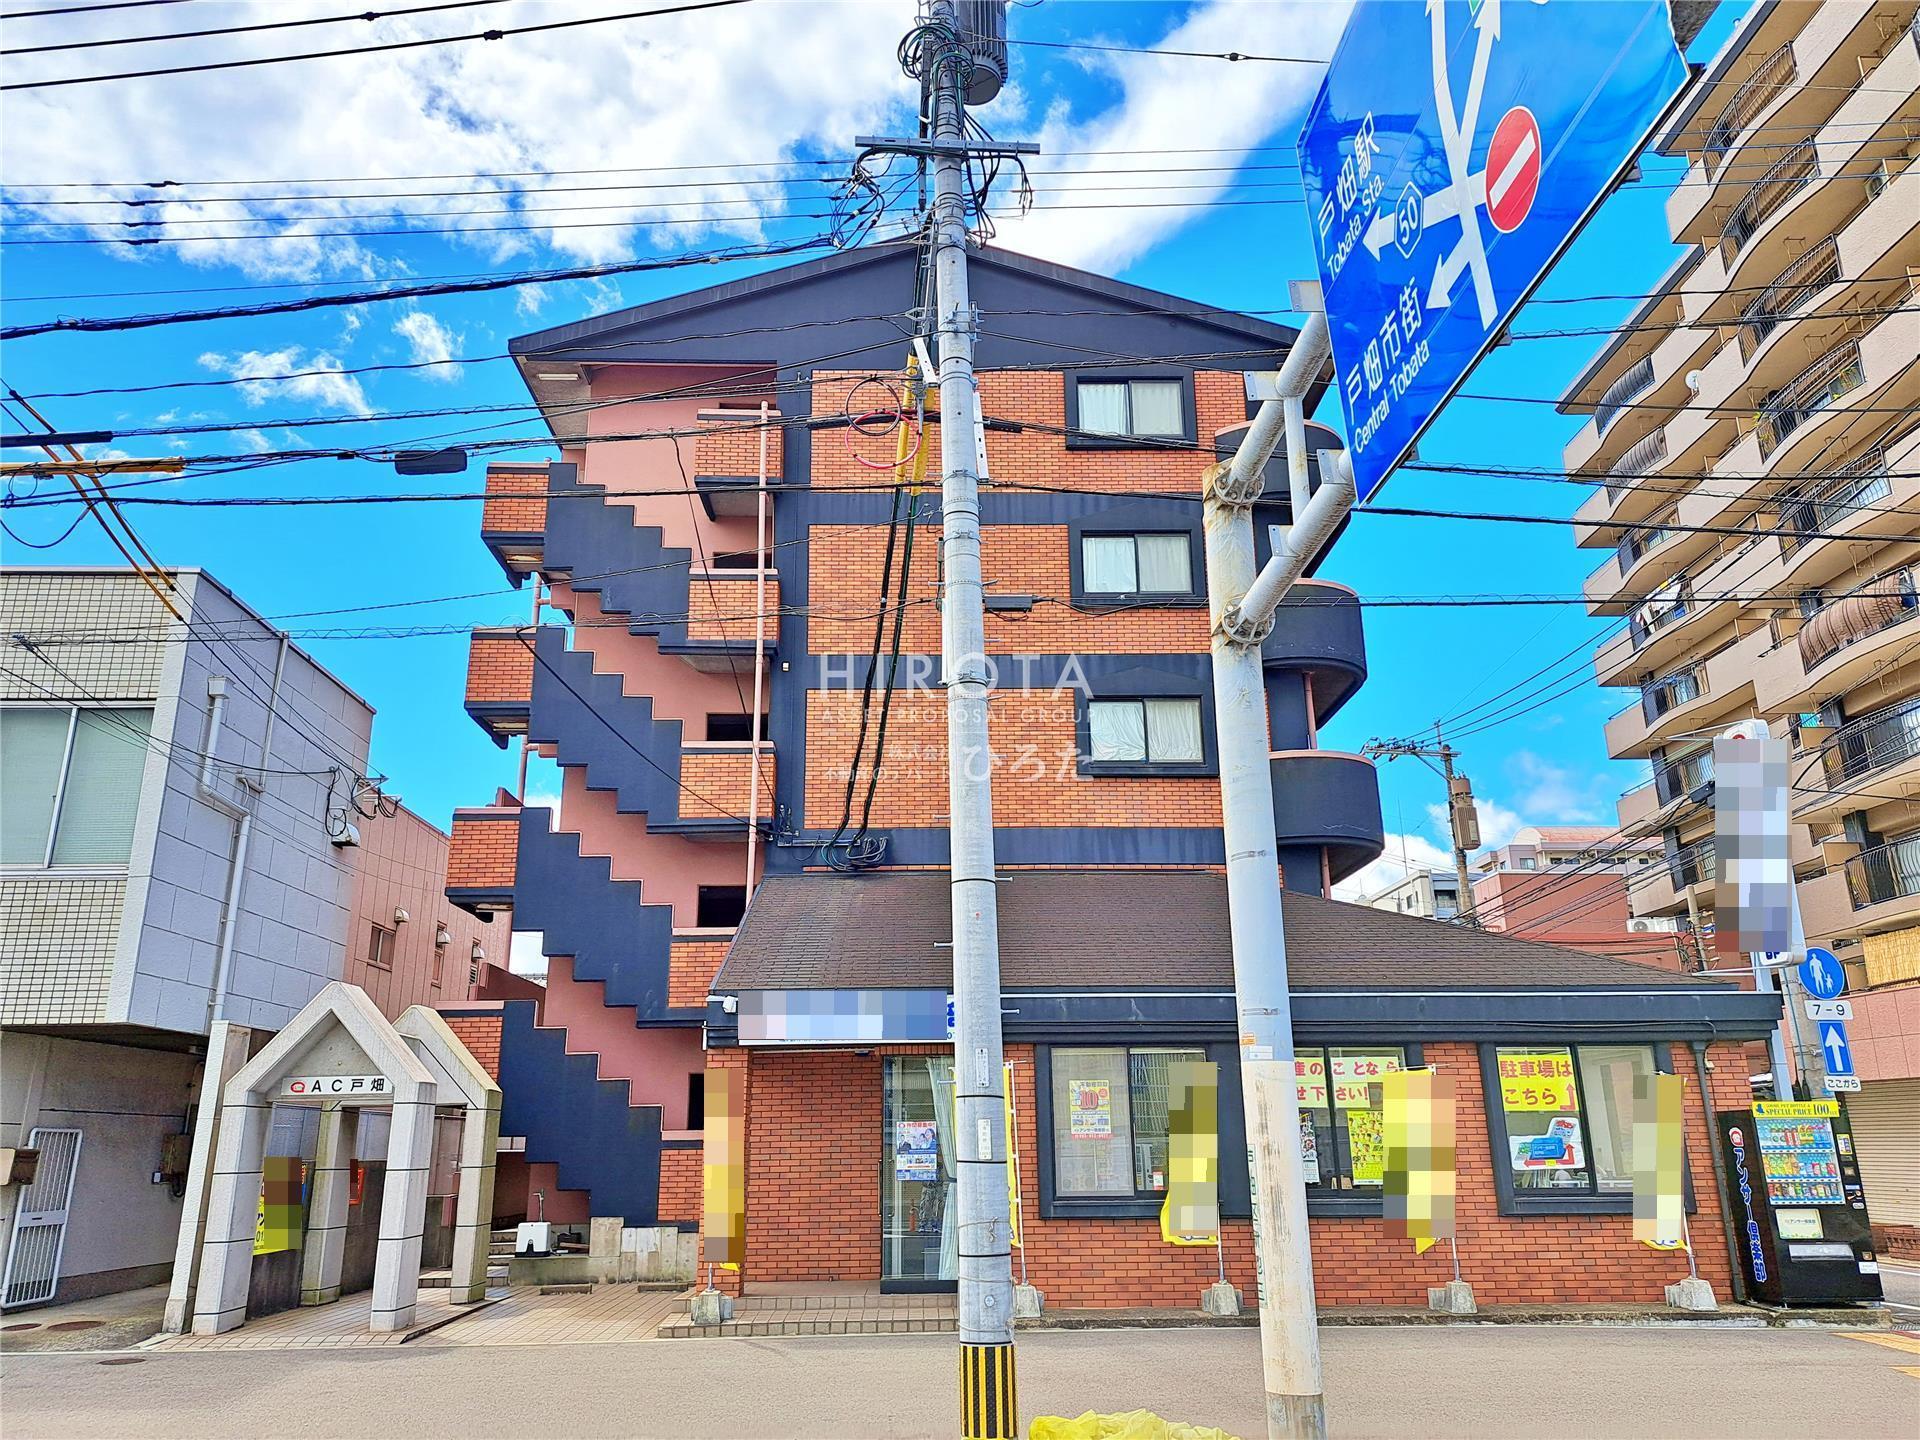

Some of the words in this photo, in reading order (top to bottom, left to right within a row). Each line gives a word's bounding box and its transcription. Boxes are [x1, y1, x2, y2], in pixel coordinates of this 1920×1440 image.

[1317, 110, 1381, 260] 戸畑駅
[1327, 214, 1363, 281] Tobata
[1362, 174, 1385, 217] Sta.
[1399, 196, 1419, 245] 50
[1345, 276, 1422, 426] 戸畑市街
[1354, 389, 1391, 454] Central
[1389, 339, 1431, 402] Tobata
[1500, 1060, 1573, 1078] 駐車場は
[1827, 1079, 1859, 1089] ここから
[1504, 1088, 1557, 1105] こちら
[1813, 1103, 1830, 1116] 100
